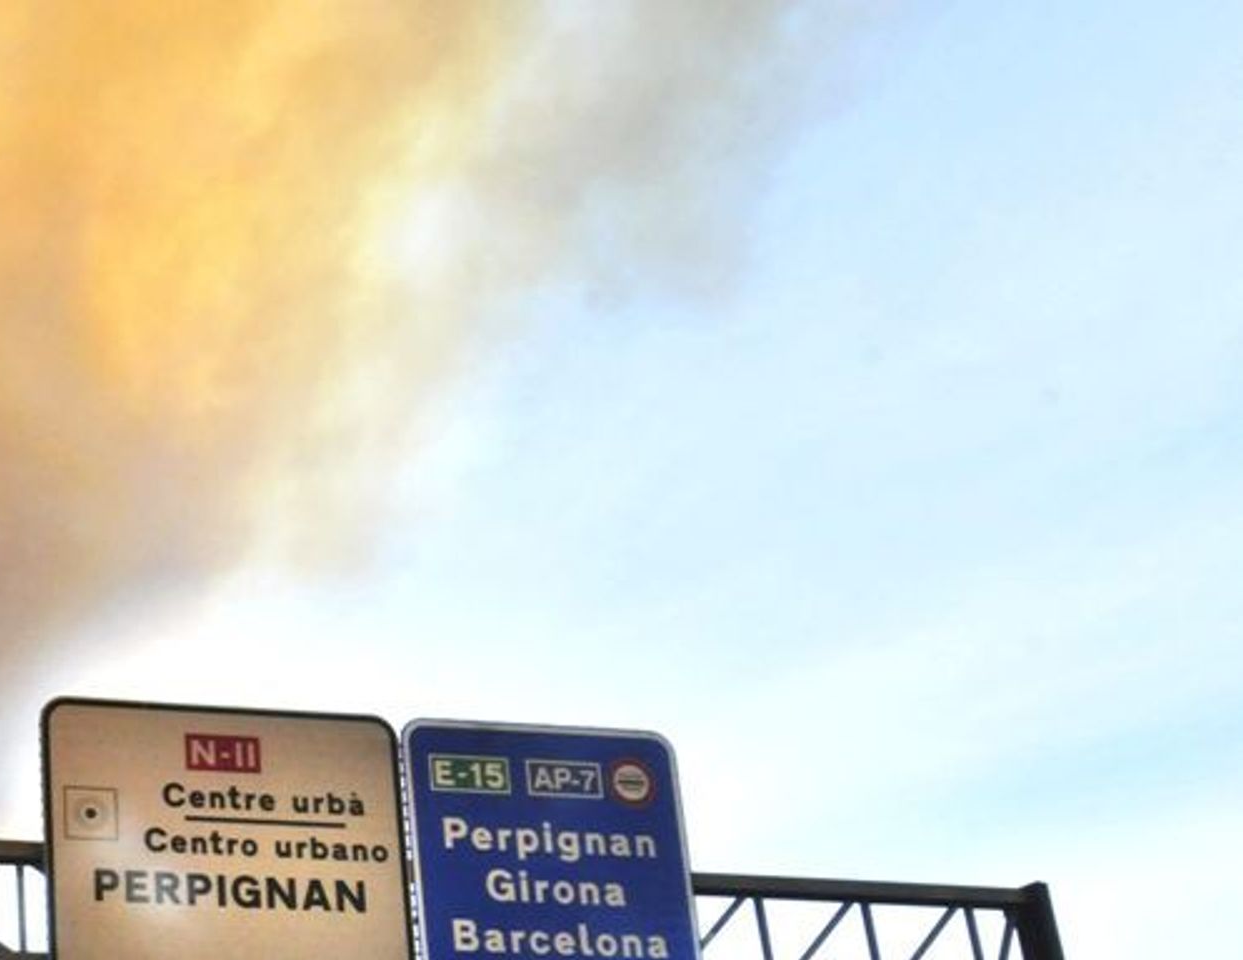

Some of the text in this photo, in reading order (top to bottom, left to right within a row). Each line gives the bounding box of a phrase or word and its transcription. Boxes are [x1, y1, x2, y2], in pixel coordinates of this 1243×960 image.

[189, 740, 257, 767] N-II
[434, 759, 505, 788] E-15
[533, 767, 596, 792] AP-7
[162, 782, 277, 812] Centre
[145, 827, 390, 863] Centro urbano
[443, 817, 657, 861] Perpignan
[93, 869, 368, 913] PERPIGNAN
[486, 868, 627, 907] Girona
[452, 919, 669, 960] Barcelona
